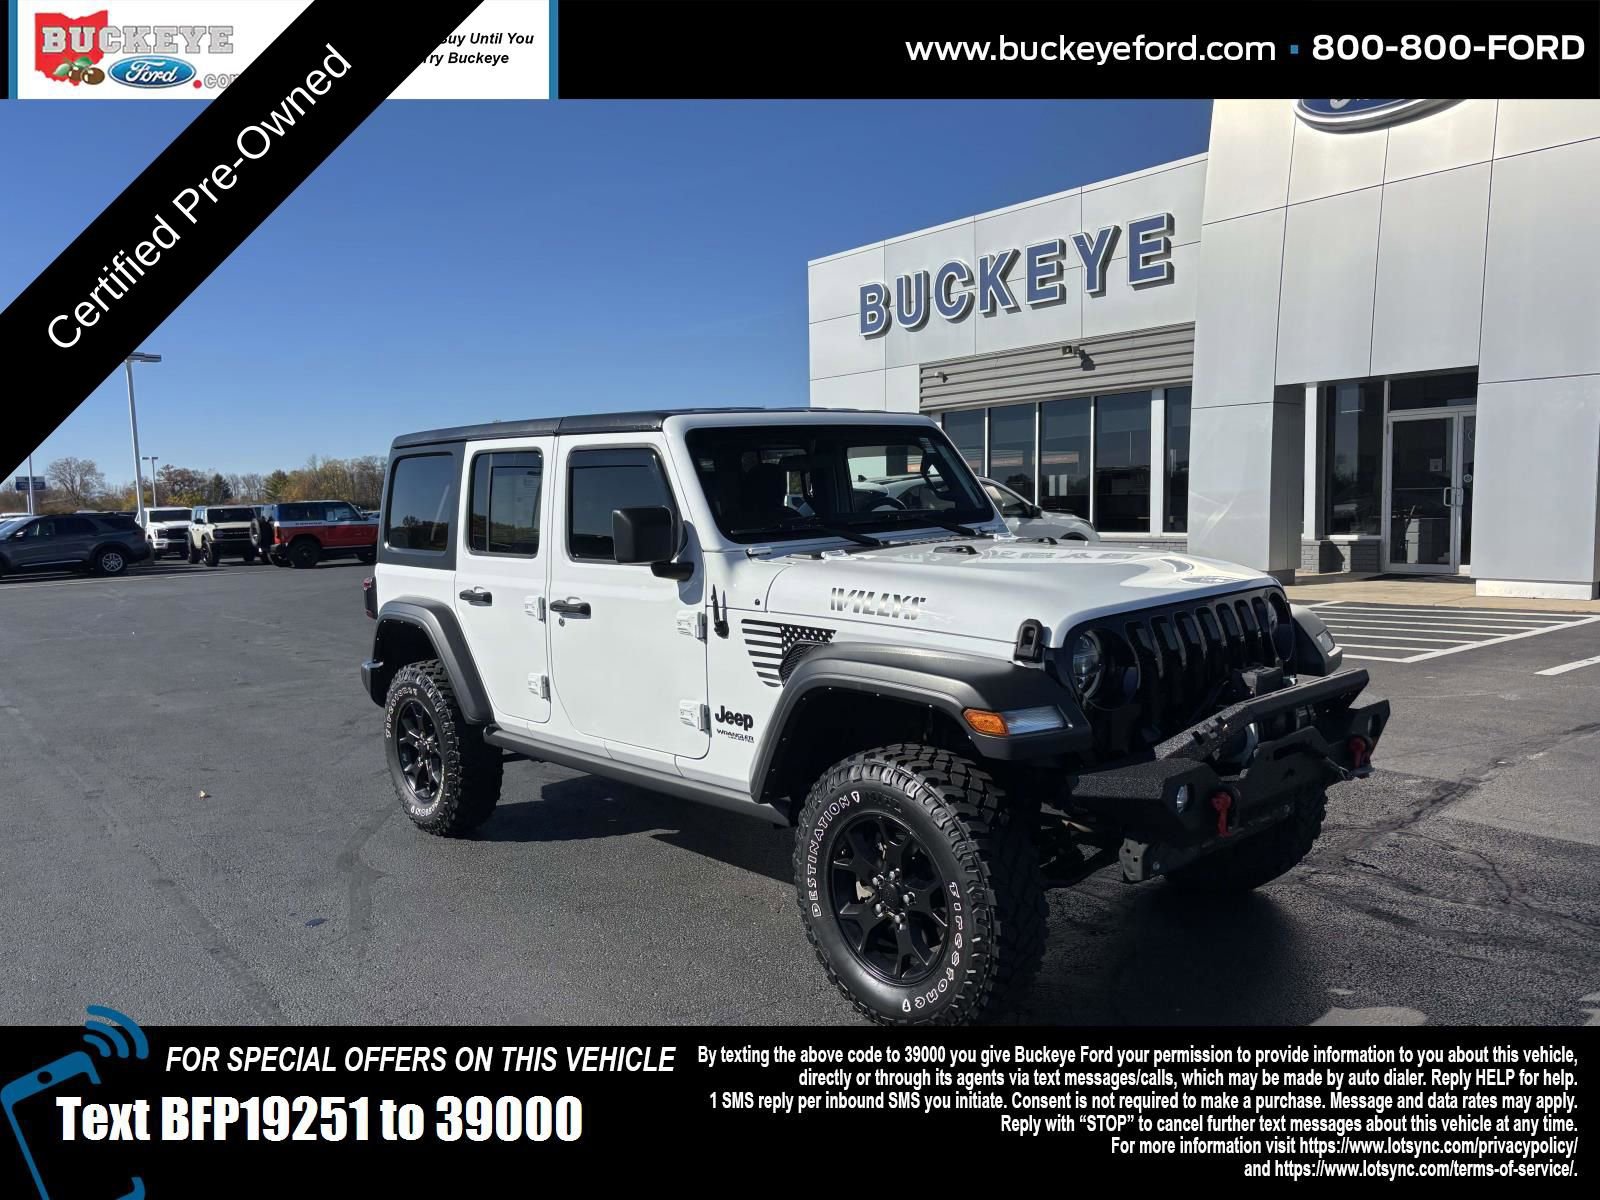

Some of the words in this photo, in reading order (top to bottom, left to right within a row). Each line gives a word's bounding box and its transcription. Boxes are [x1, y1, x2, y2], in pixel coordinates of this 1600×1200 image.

[858, 211, 1175, 340] BUCKEYE
[830, 586, 926, 621] WILLYS
[714, 704, 754, 731] Jeep
[807, 793, 850, 917] DESTINATION
